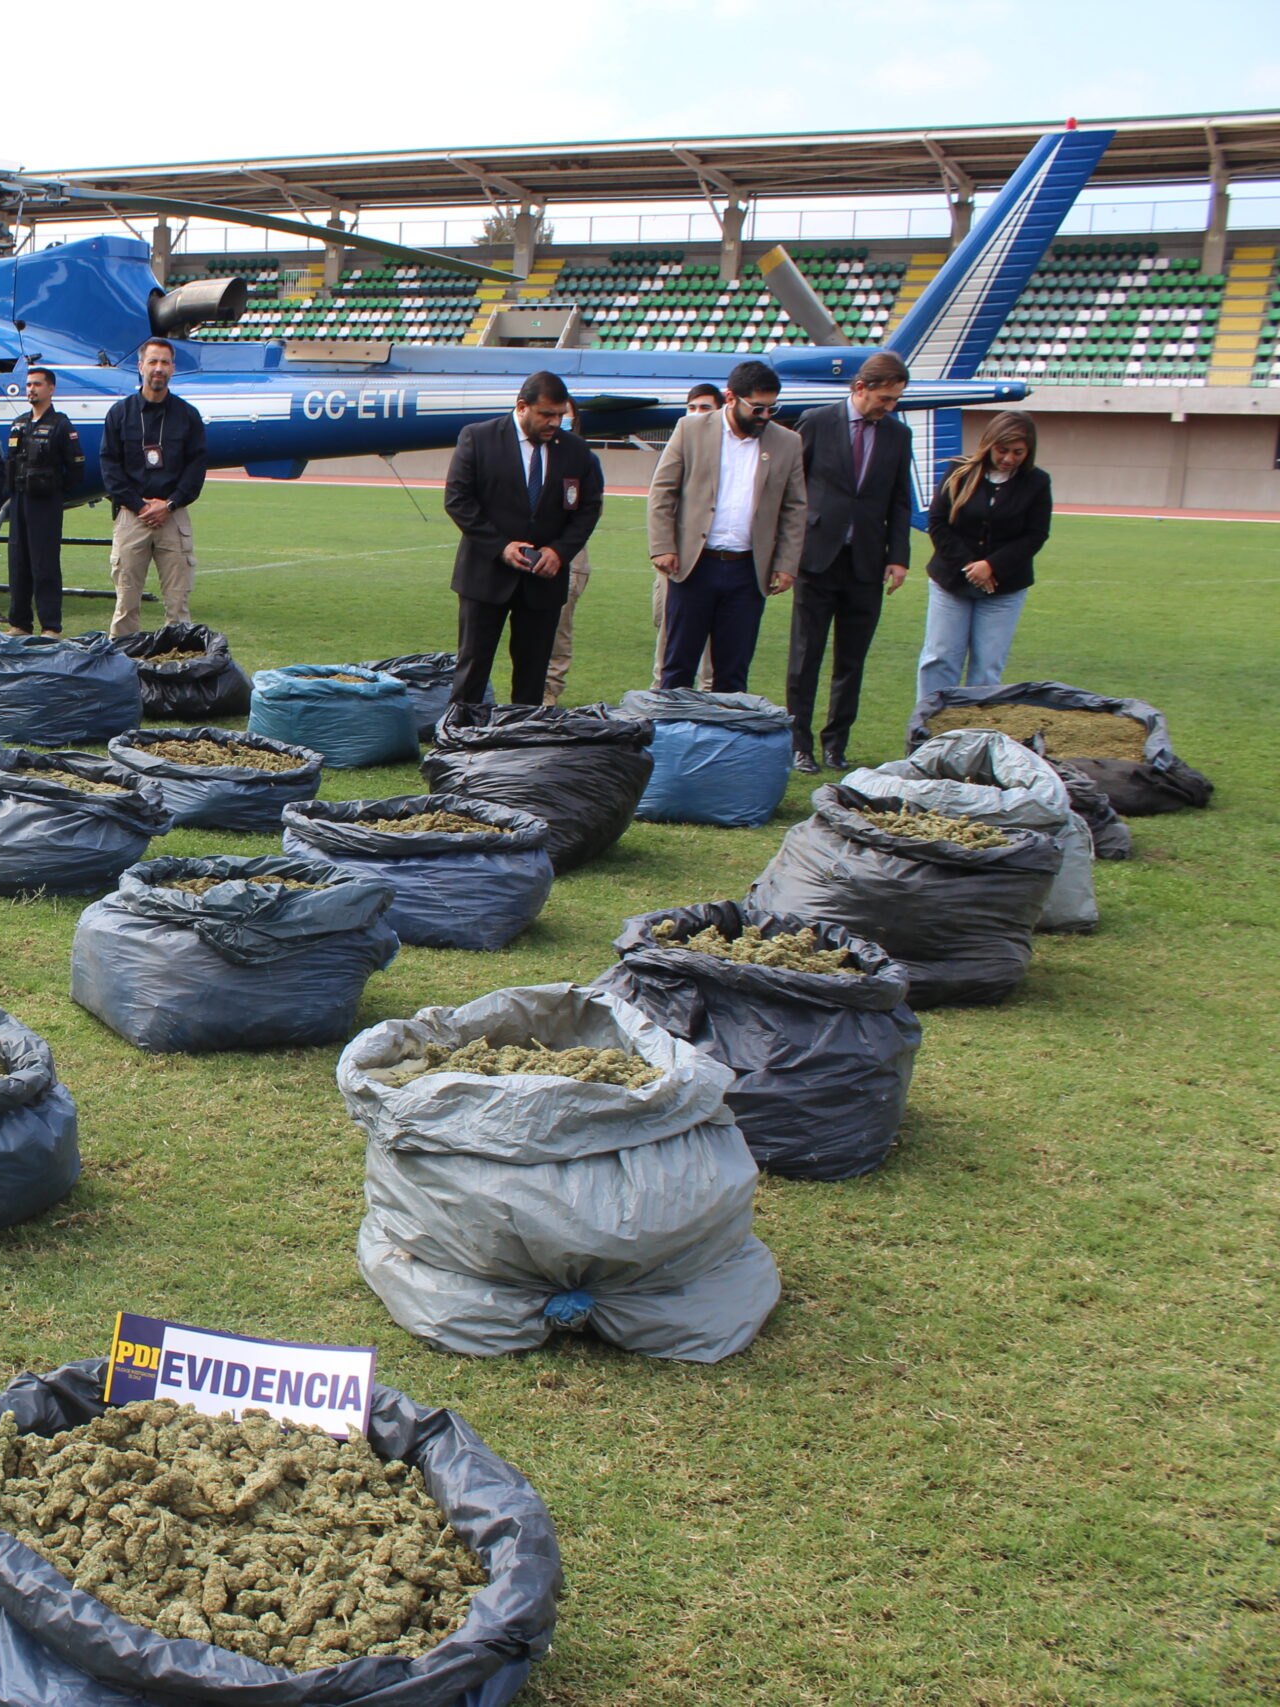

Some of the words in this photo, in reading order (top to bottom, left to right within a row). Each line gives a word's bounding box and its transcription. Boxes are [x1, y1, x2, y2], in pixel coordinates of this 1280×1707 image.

[303, 389, 405, 420] CC-ETI
[115, 1340, 161, 1370] PDI
[160, 1350, 362, 1411] EVIDENCIA
